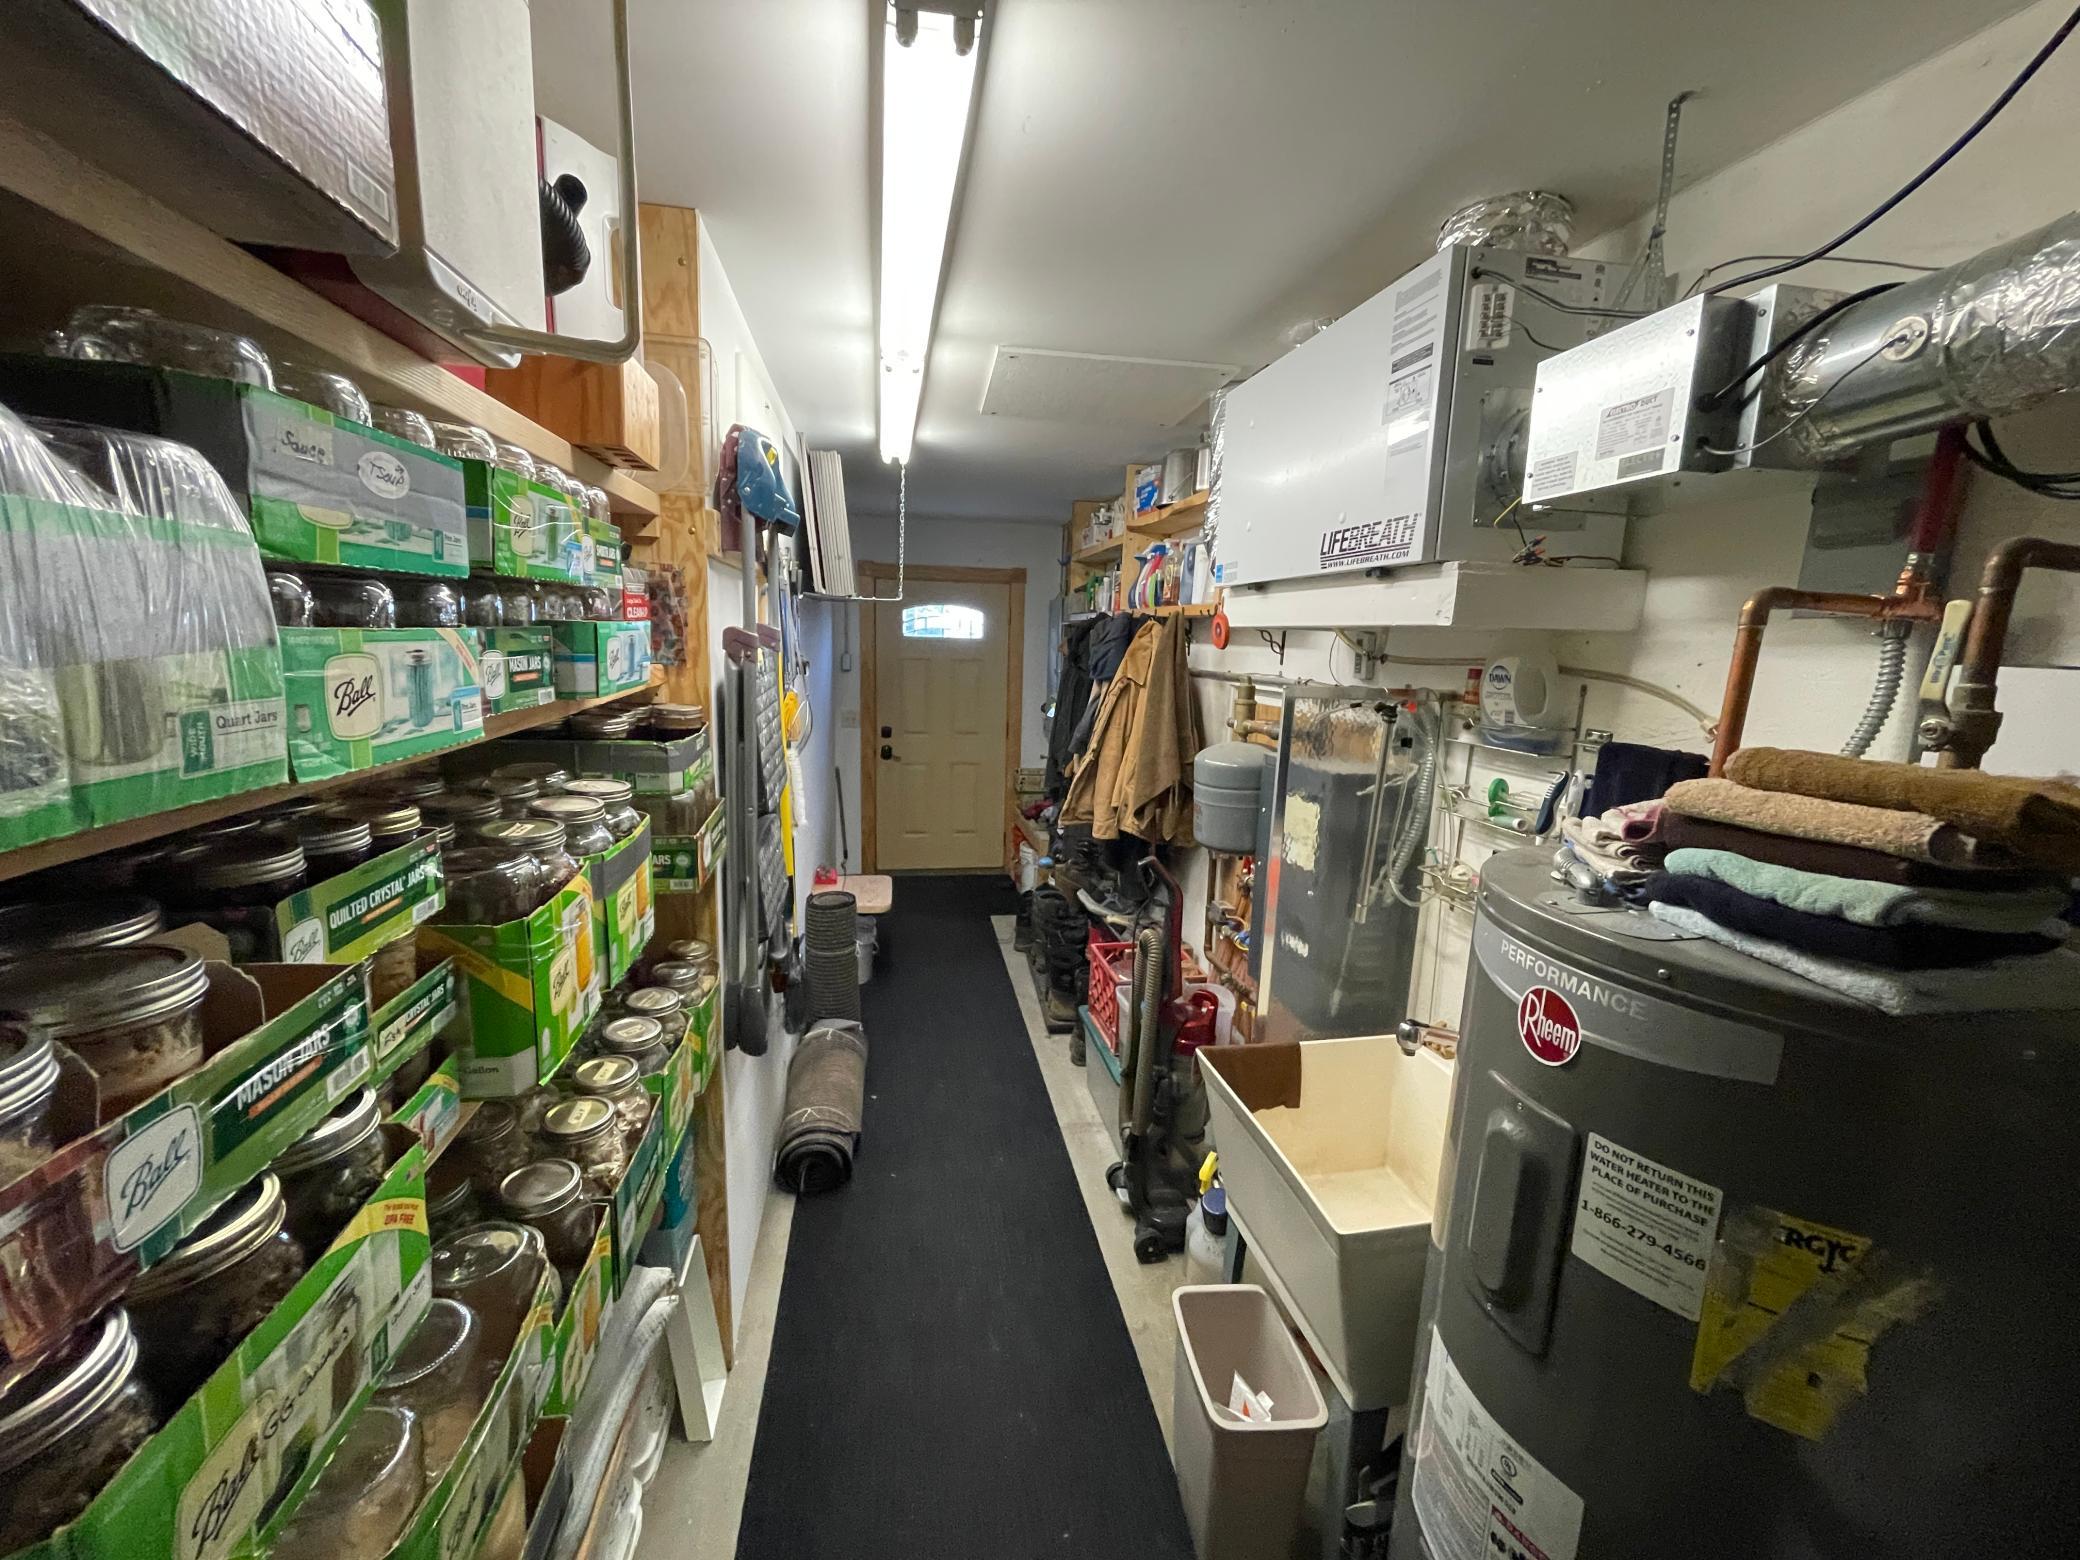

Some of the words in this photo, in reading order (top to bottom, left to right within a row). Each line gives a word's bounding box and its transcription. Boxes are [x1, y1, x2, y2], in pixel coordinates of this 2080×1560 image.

[1320, 513, 1418, 555] LIFEBREATH
[1328, 550, 1410, 568] WWW.LIFEBREATH.COM
[528, 655, 541, 670] JARS
[215, 714, 252, 729] Quart
[254, 710, 278, 724] Jars
[334, 675, 376, 717] Ball
[652, 854, 671, 866] ARS
[330, 900, 369, 929] QUILTED
[369, 878, 405, 909] CRYSTAL
[407, 865, 427, 889] JARS
[1500, 939, 1648, 1021] PERFORMANCE
[1522, 988, 1576, 1054] Rheem
[236, 1052, 294, 1111] MASON
[300, 1023, 330, 1061] JARS
[120, 1128, 191, 1221] Ball
[1590, 1150, 1625, 1175] WATER
[1626, 1170, 1670, 1196] HEATER
[1672, 1187, 1689, 1204] TO
[1691, 1196, 1716, 1216] THE
[1592, 1165, 1624, 1188] PLACE
[1626, 1183, 1641, 1195] OF
[1643, 1191, 1709, 1226] PURCHASE
[1594, 1140, 1610, 1154] DO
[1612, 1149, 1635, 1166] NOT
[1636, 1162, 1684, 1190] RETURN
[1685, 1183, 1715, 1202] THIS
